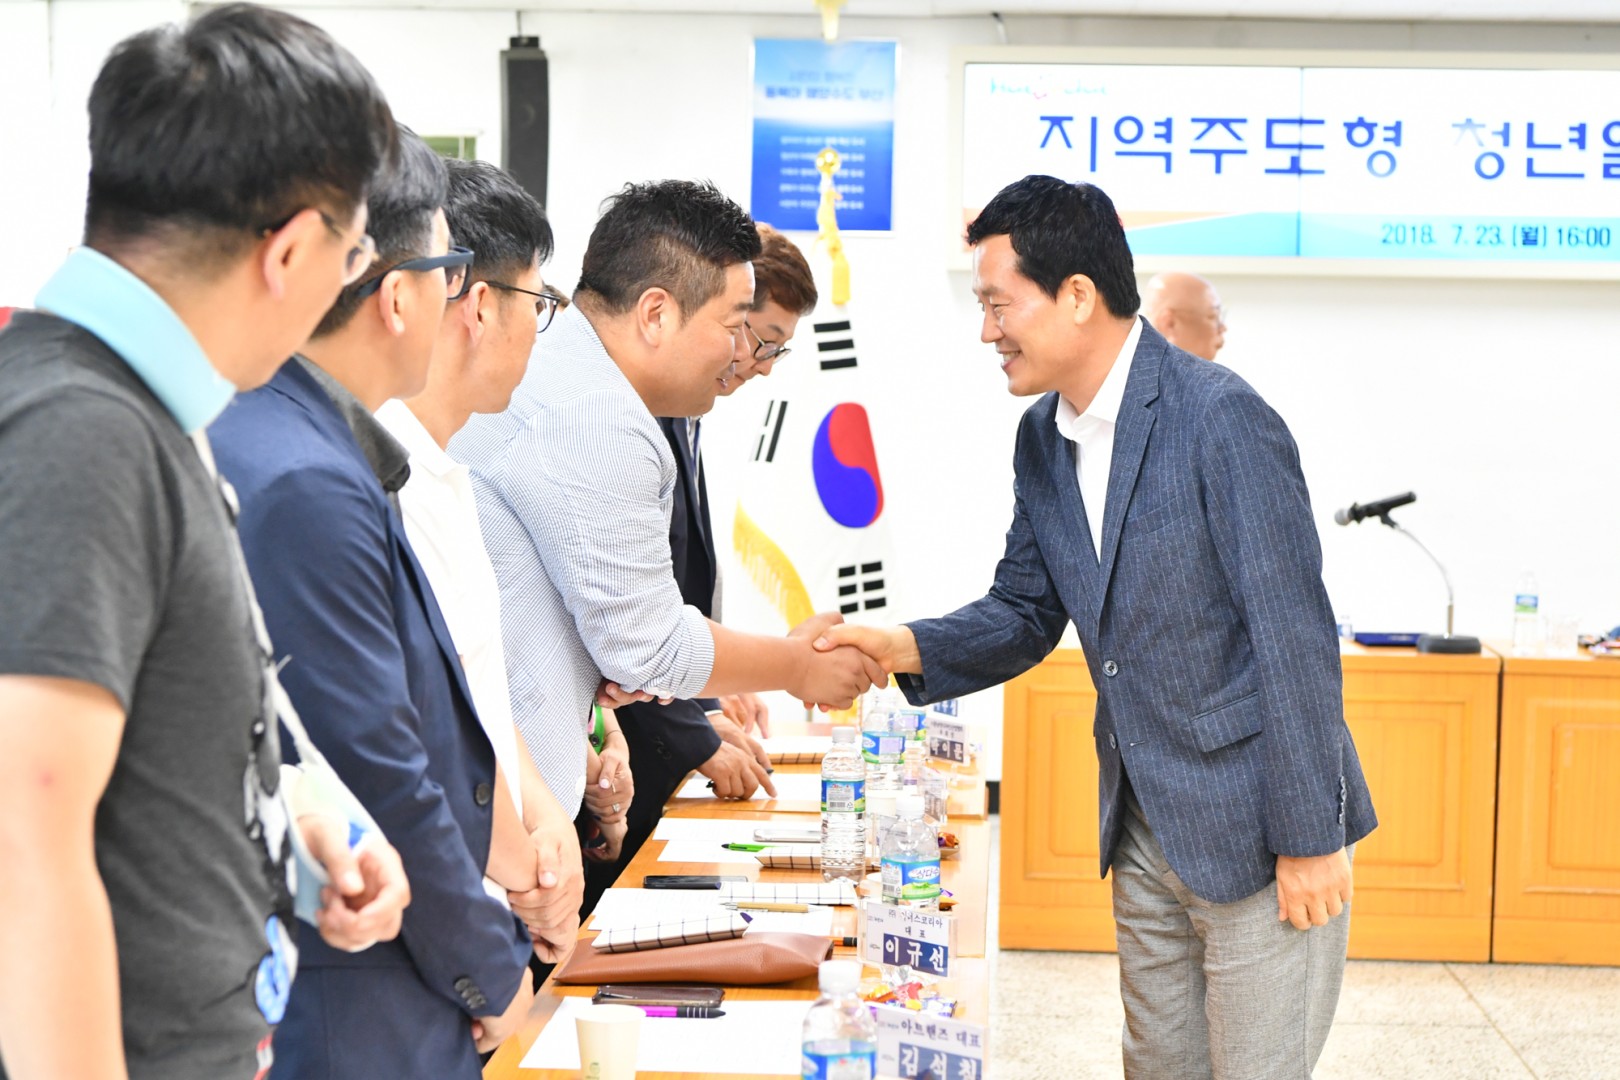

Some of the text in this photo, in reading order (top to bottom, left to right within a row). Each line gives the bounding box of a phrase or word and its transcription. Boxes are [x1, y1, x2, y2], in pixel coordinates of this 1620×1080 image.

[1039, 115, 1403, 179] 지역주도형
[1556, 225, 1612, 249] 16:00
[885, 936, 945, 973] 이규선
[956, 1031, 981, 1047] 대표
